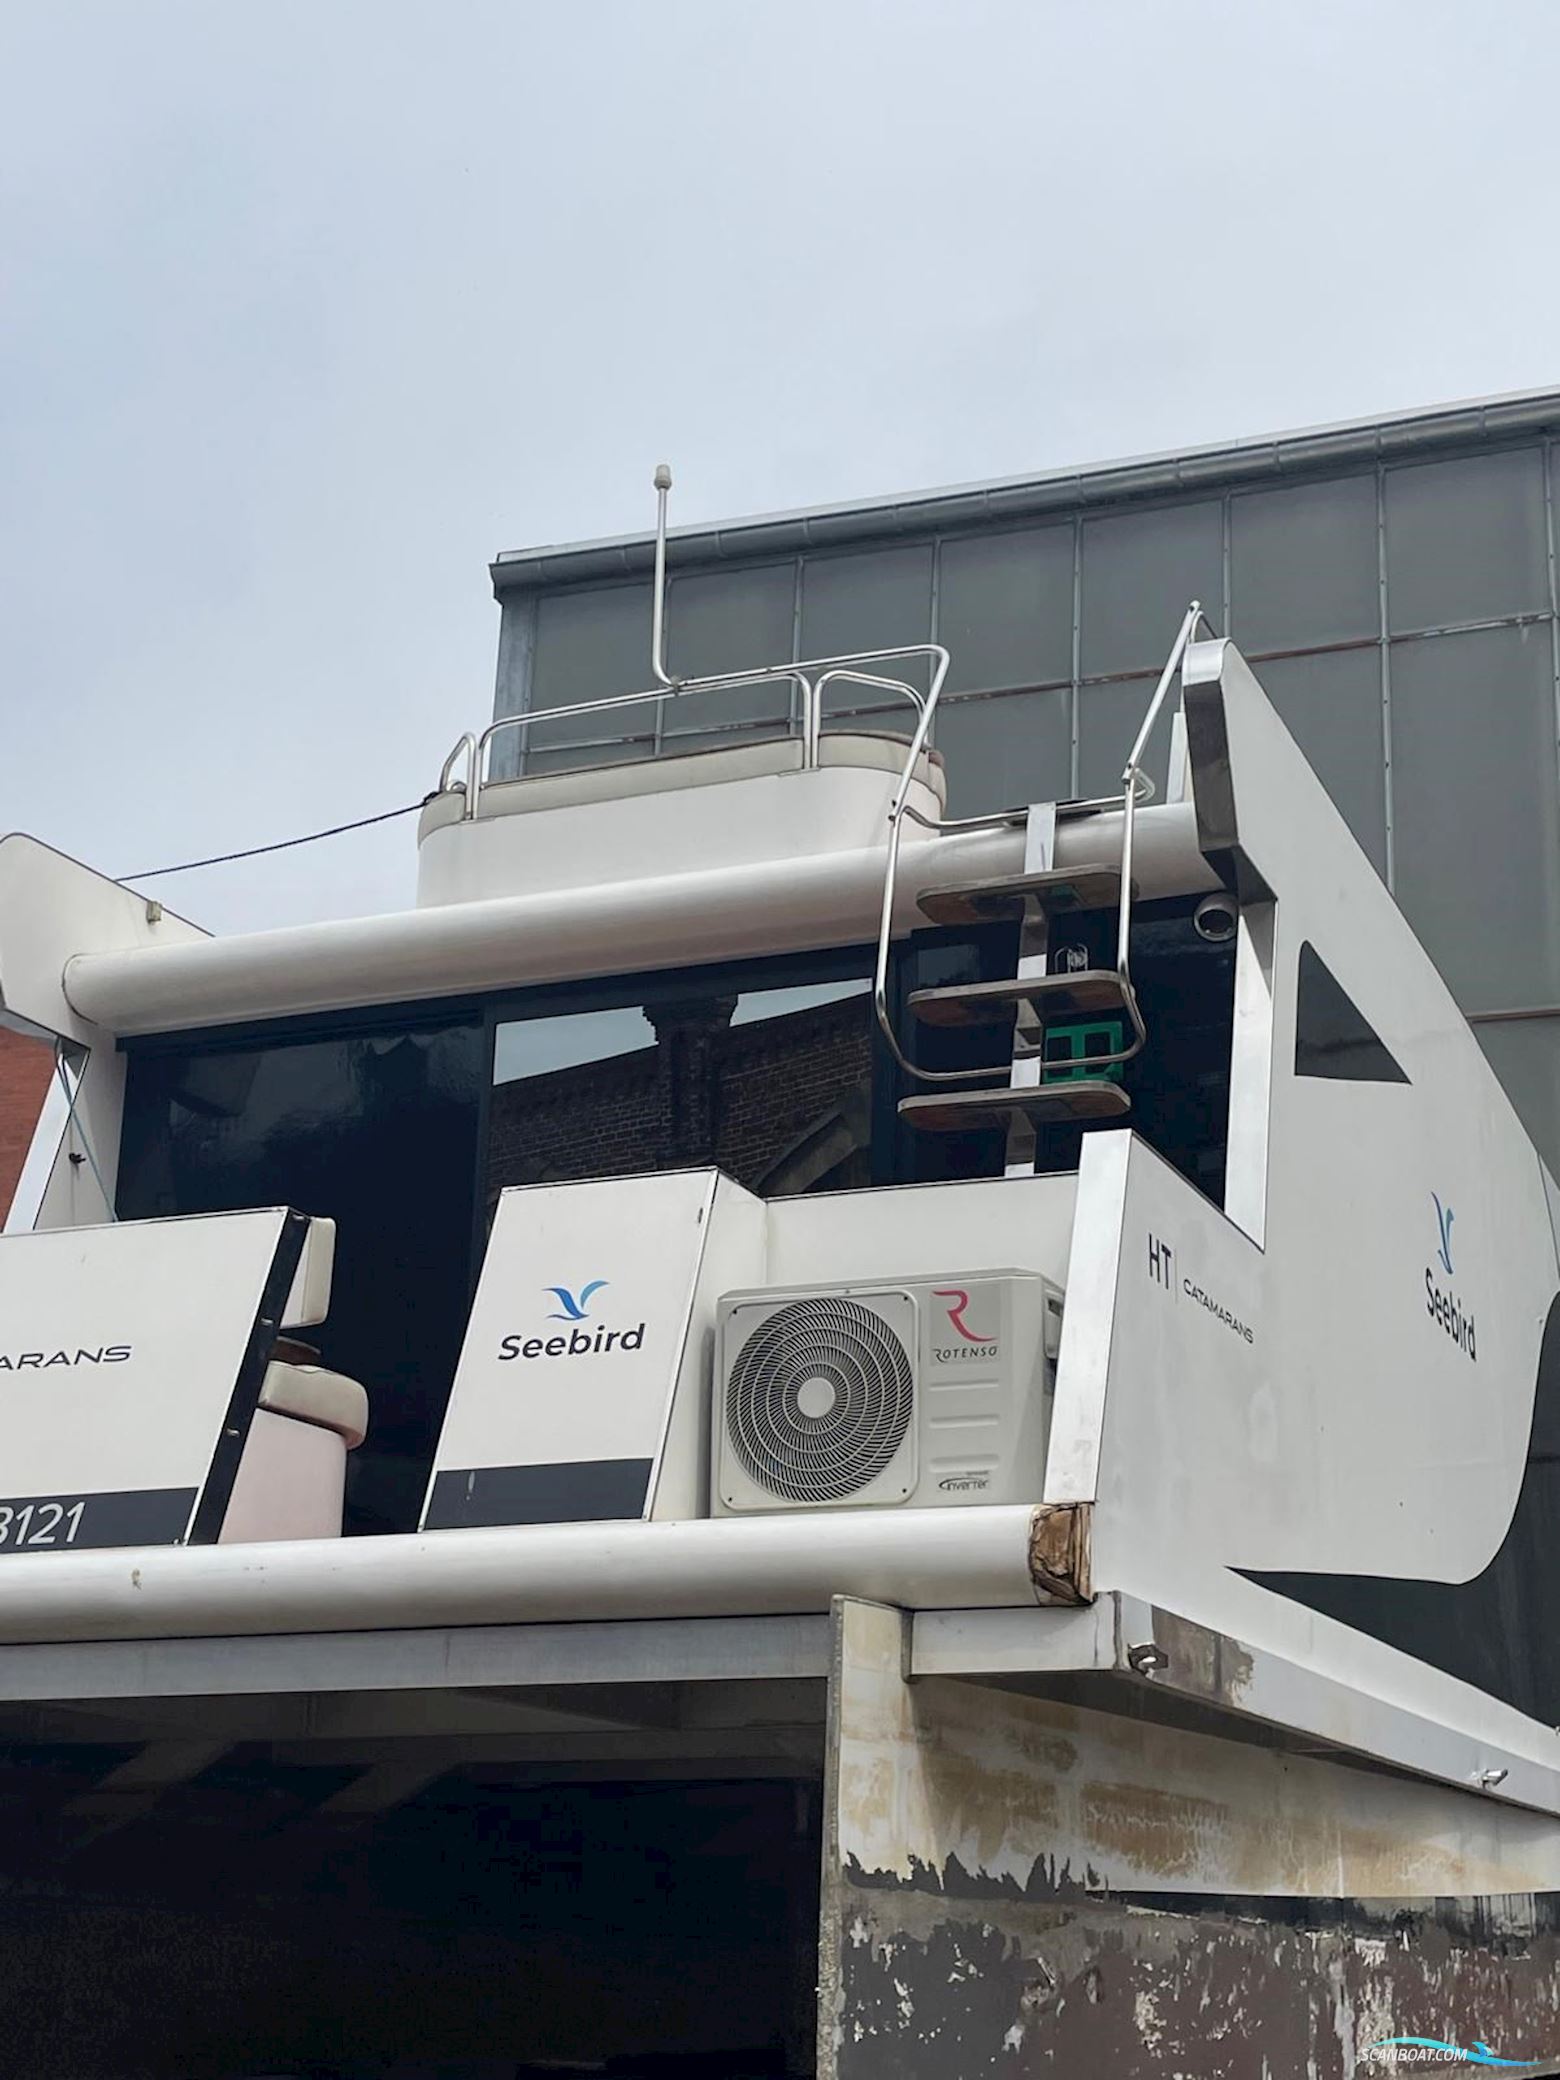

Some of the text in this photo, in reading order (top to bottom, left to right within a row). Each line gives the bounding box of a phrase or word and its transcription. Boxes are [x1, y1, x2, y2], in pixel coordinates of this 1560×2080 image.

[1149, 1233, 1254, 1344] HT CATAMARANS
[1426, 1267, 1476, 1361] Seebird
[498, 1323, 645, 1360] Seebird
[932, 1346, 998, 1363] ROTENSO
